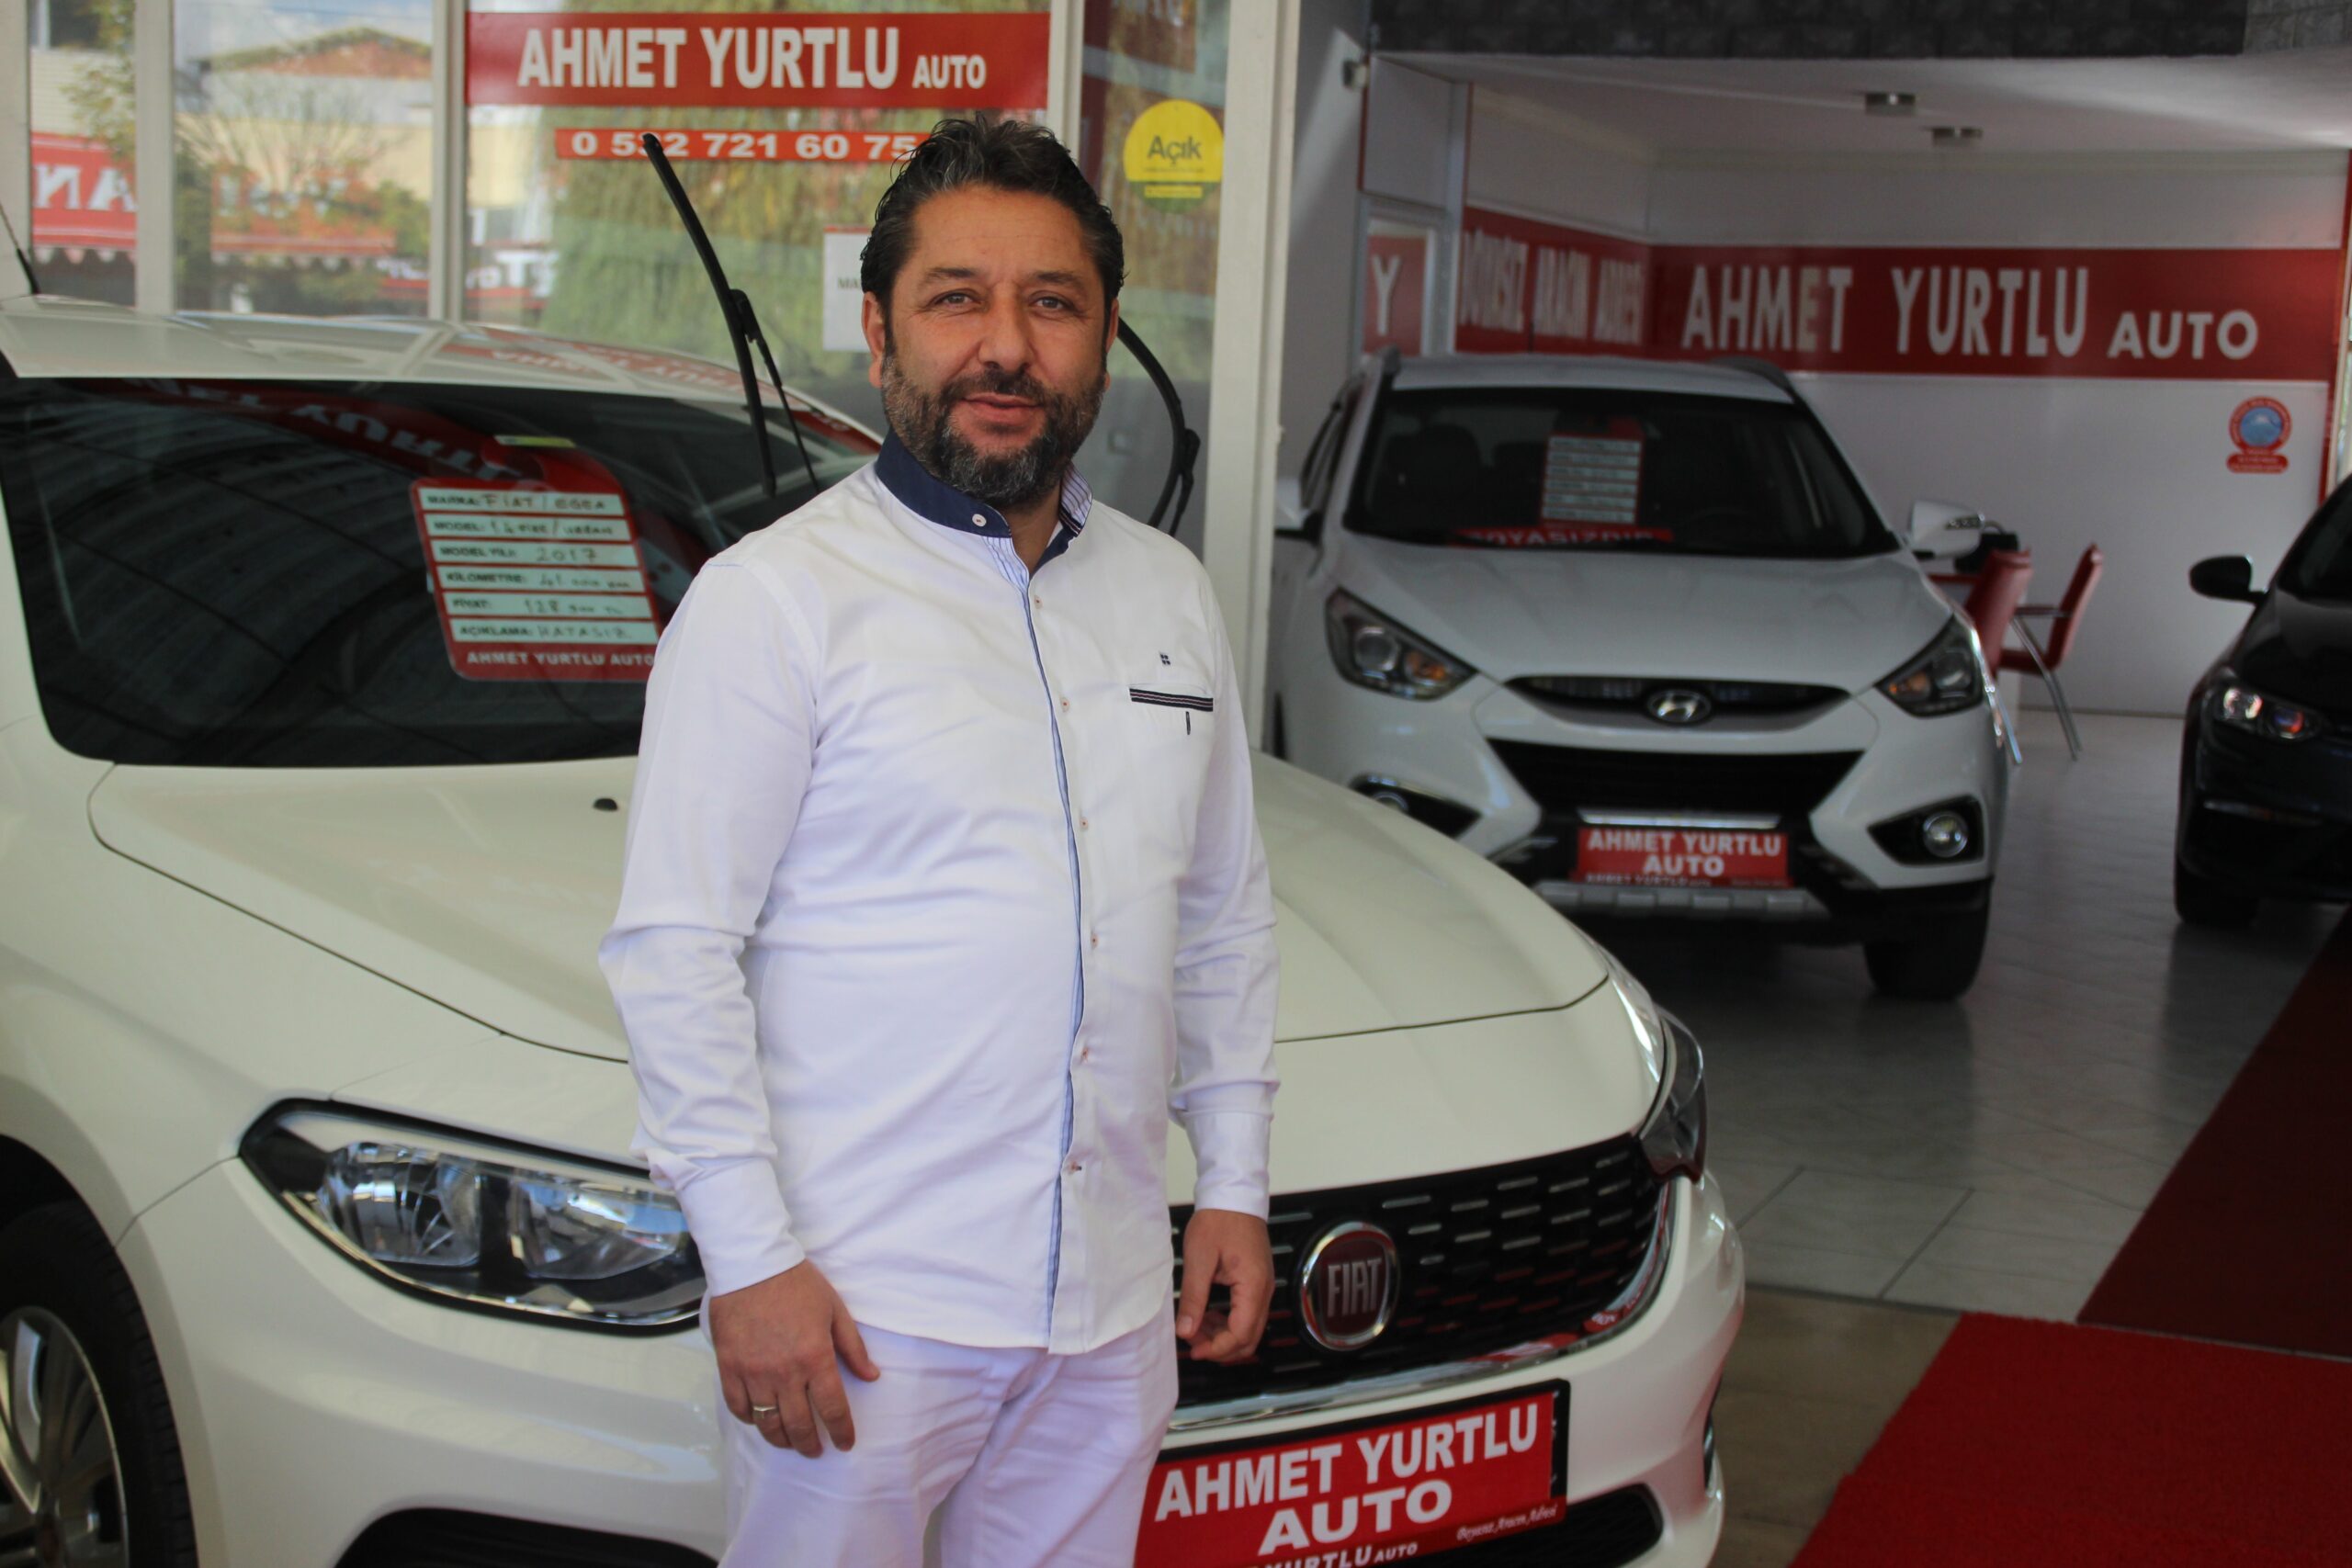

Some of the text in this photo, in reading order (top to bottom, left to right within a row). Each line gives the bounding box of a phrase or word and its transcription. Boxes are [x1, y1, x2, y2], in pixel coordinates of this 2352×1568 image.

[517, 28, 986, 89] AHMET YURTLU AUTO
[571, 131, 598, 156] 0
[611, 131, 689, 157] 52
[703, 134, 777, 158] 721
[796, 135, 849, 159] 60
[1147, 135, 1202, 164] Açık
[1682, 266, 2258, 360] AHMET YURTLU AUTO
[427, 494, 479, 507] MARKA:
[434, 520, 485, 533] MODEL:
[467, 651, 528, 666] AHMET
[534, 651, 605, 668] YURTLU
[1587, 829, 1781, 857] AHMET YURTLU
[1643, 853, 1725, 877] AUTO
[1328, 1257, 1383, 1319] FIAT
[1154, 1403, 1539, 1522] AHMET YURTLU
[1258, 1479, 1452, 1555] AUTO
[1374, 1541, 1419, 1562] AUTO
